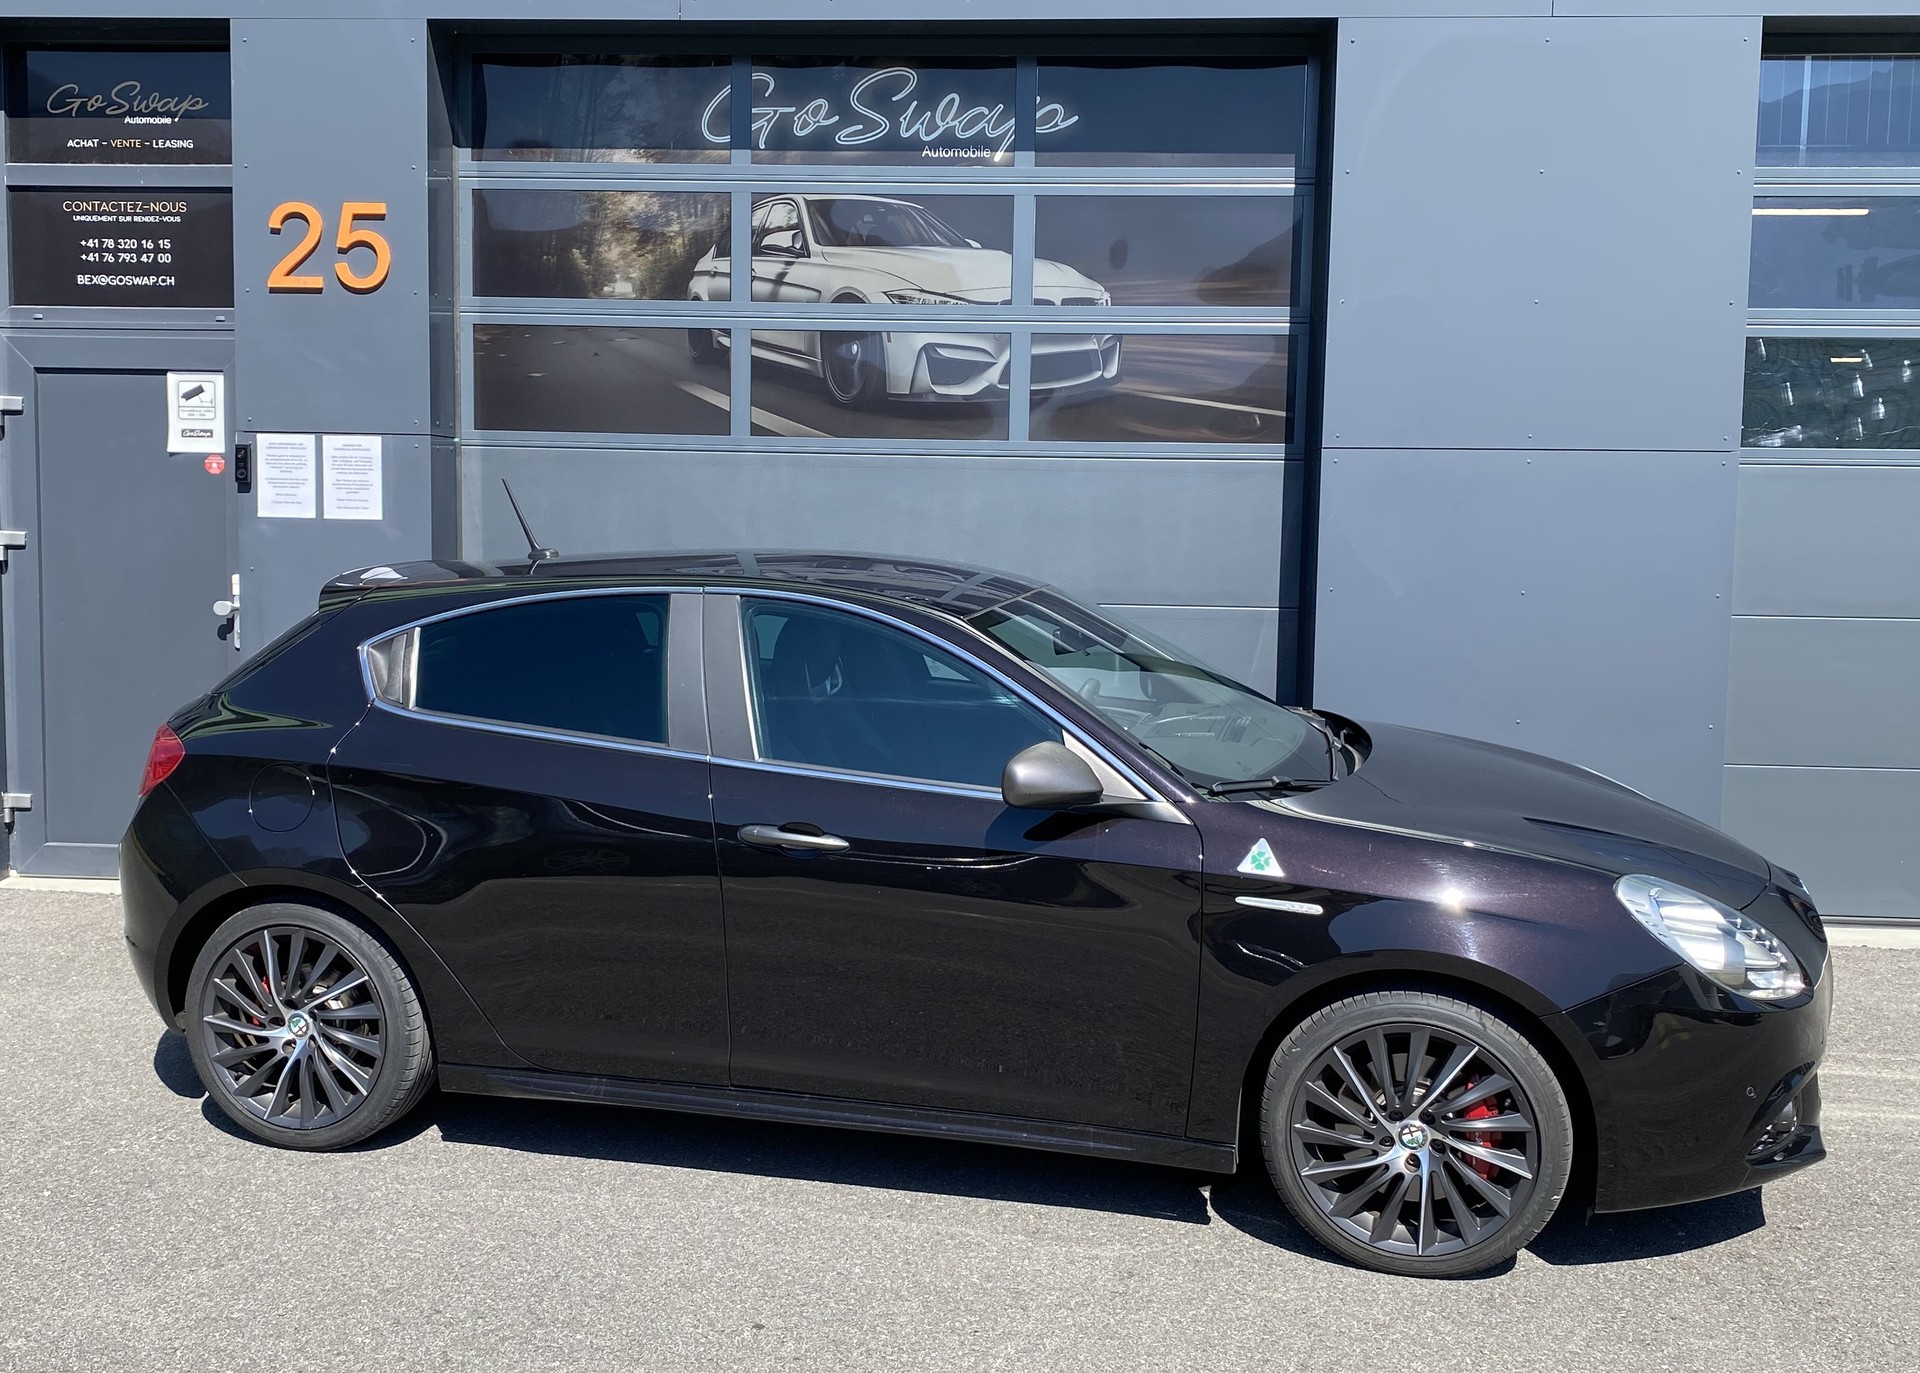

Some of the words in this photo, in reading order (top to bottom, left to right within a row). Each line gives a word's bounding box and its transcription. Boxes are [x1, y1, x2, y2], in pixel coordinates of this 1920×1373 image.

[124, 115, 172, 124] Automobile
[67, 139, 99, 148] ACHAT
[110, 139, 141, 148] VENTE
[152, 139, 194, 149] LEASING
[921, 145, 991, 158] Automobile
[63, 201, 187, 213] CONTACTEZ-NOUS
[133, 215, 181, 223] RENDEZ-VOUS
[80, 239, 99, 249] +41
[101, 239, 115, 249] 78
[117, 239, 138, 249] 320
[141, 239, 154, 249] 16
[158, 239, 171, 249] 15
[267, 201, 391, 294] 25
[80, 253, 99, 263] +41
[101, 253, 115, 263] 76
[117, 253, 138, 263] 793
[139, 253, 154, 263] 47
[157, 253, 172, 263] 00
[77, 274, 175, 286] BEX@GOSWAP.CH
